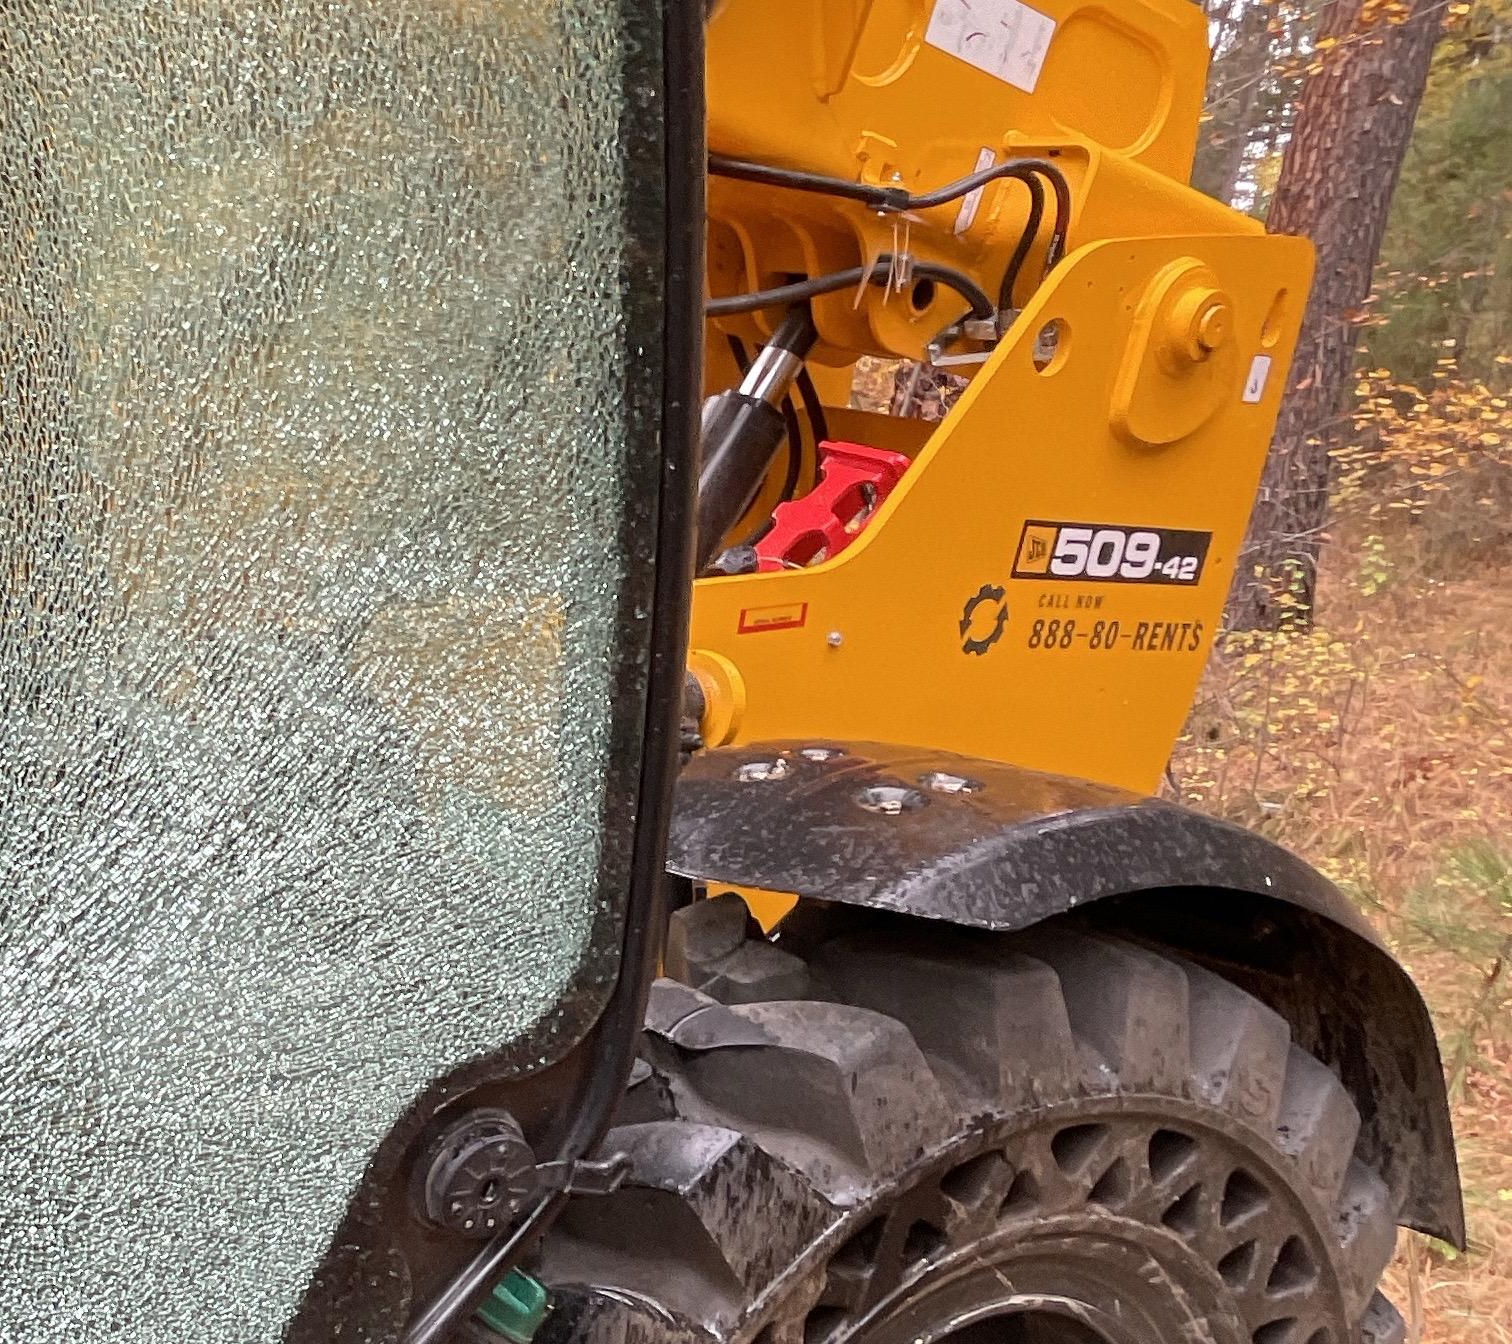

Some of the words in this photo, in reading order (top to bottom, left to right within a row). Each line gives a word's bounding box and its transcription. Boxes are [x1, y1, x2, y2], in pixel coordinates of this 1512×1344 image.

[1050, 527, 1198, 581] 509-42
[1039, 593, 1069, 609] CALL
[1076, 594, 1105, 609] NOW
[1028, 618, 1203, 652] 888-80-RENTS
